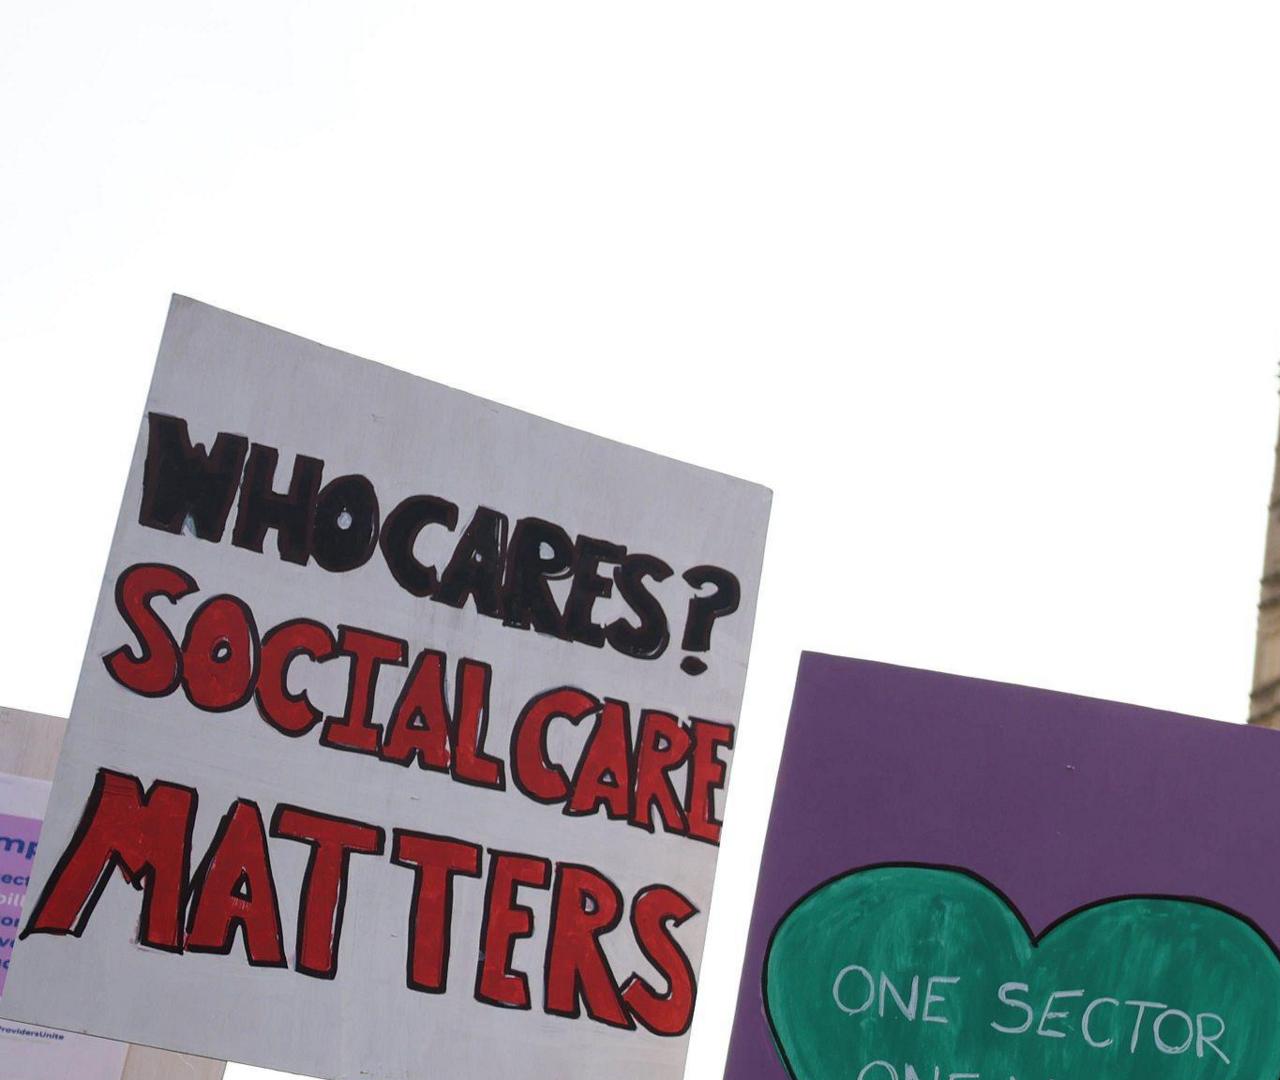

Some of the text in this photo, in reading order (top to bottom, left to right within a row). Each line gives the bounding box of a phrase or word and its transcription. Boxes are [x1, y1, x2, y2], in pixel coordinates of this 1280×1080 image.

[20, 768, 701, 1036] MATTERS
[832, 964, 1230, 1064] ONE SECTOR
